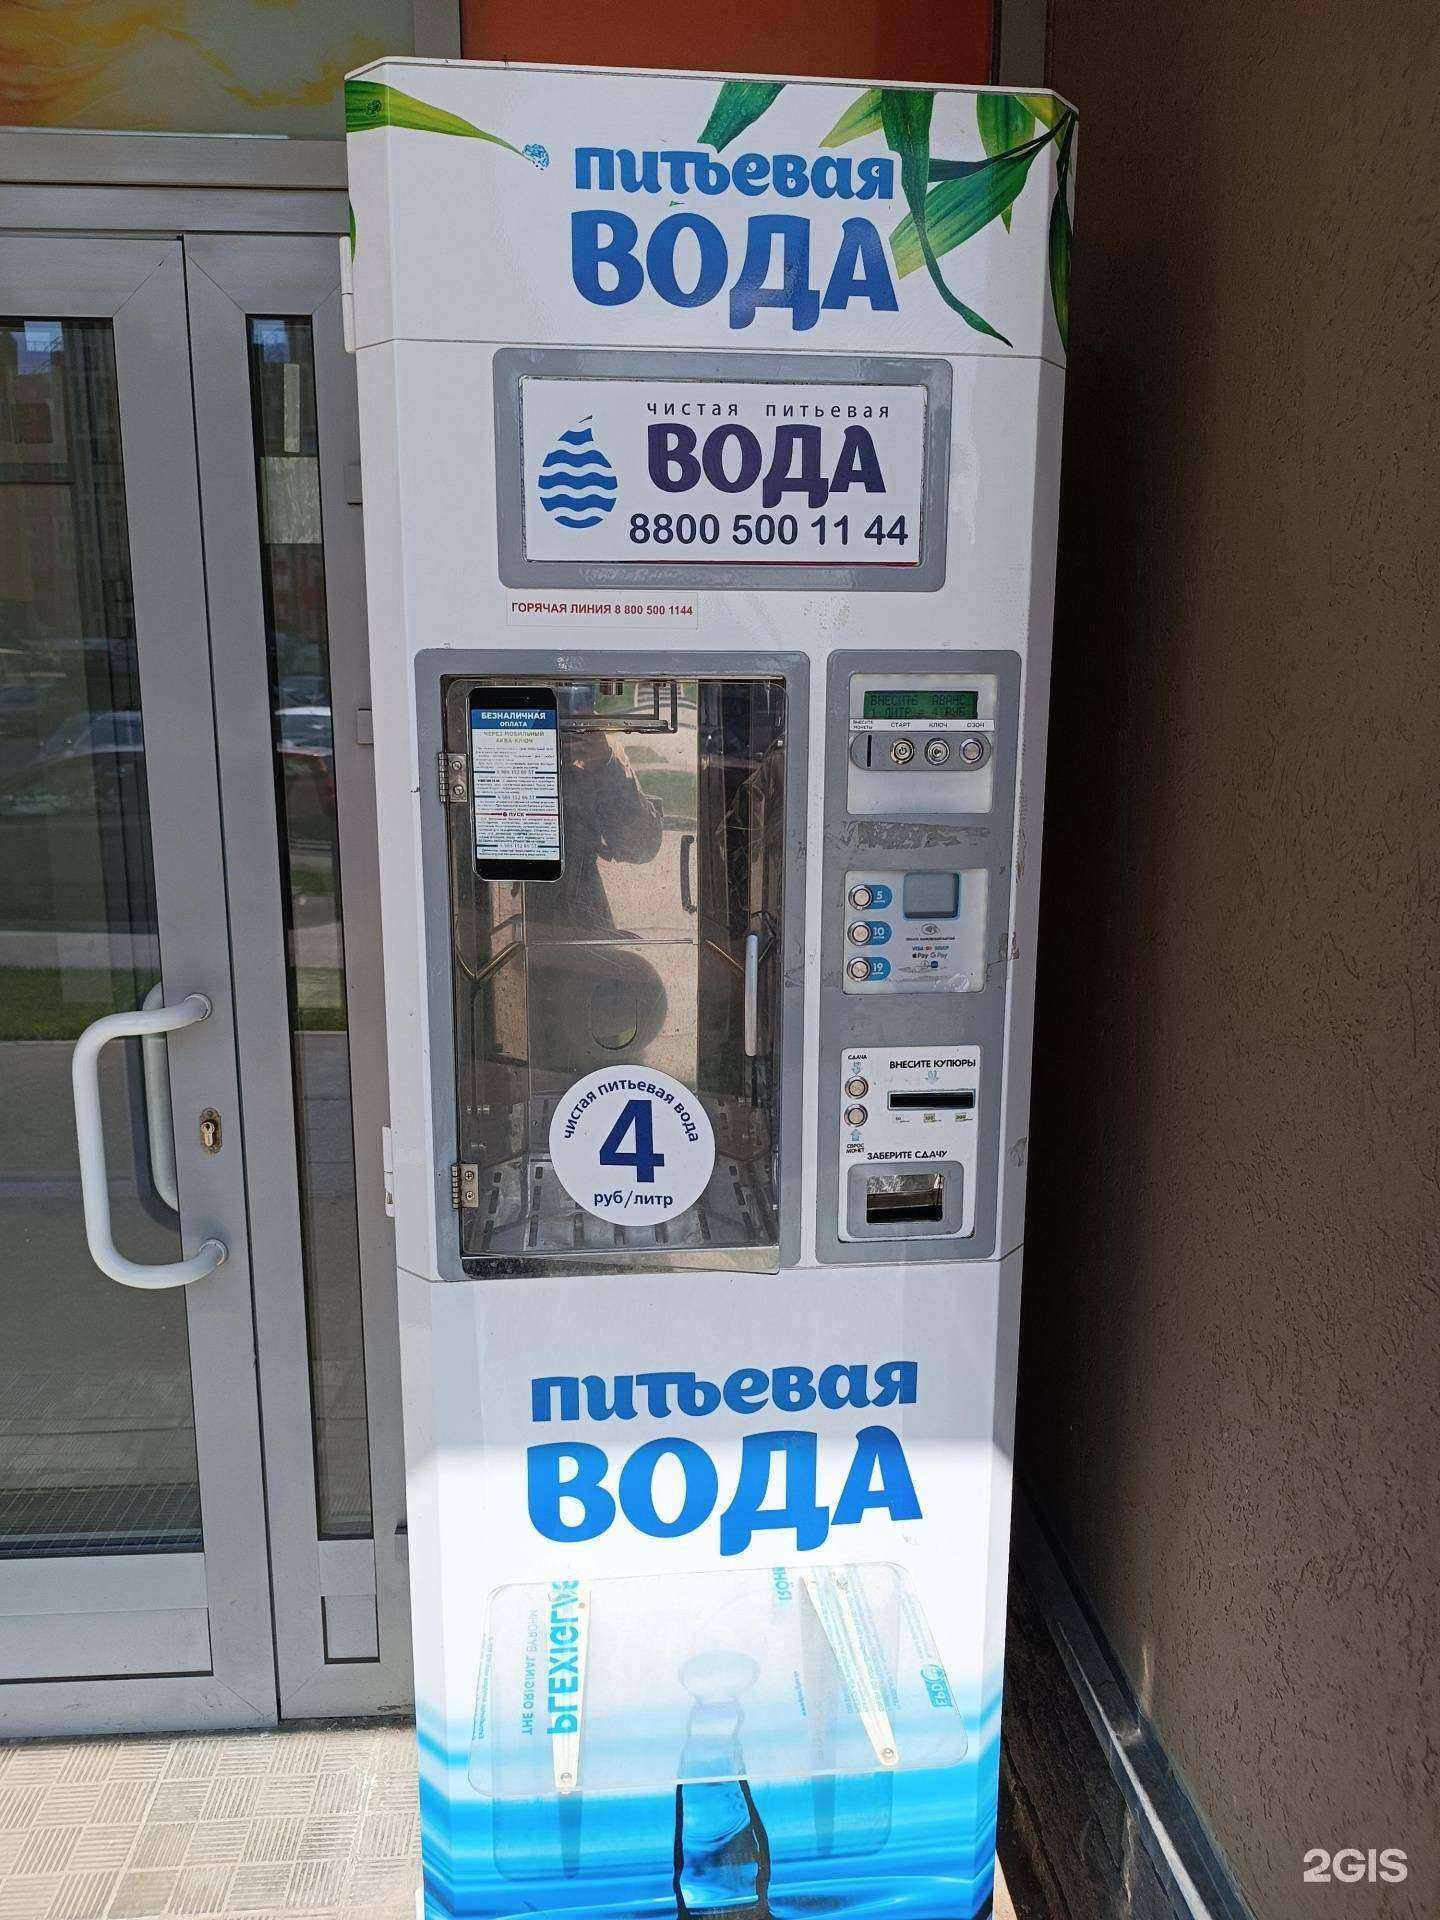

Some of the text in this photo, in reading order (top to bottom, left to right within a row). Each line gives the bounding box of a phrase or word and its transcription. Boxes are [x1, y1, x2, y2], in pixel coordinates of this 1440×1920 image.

[575, 146, 894, 200] питьевая
[570, 210, 900, 331] ВОДА
[646, 402, 891, 420] чистая питьевая
[647, 424, 886, 509] ВОДА
[629, 513, 909, 546] 8800 500 11 44
[511, 602, 693, 616] ГОРЯЧАЯ ЛИНИЯ 8 800 500 1144
[481, 712, 546, 720] БЕЗНАЛИЧНАЯ
[876, 891, 883, 899] 5
[873, 927, 885, 936] 10
[872, 963, 883, 971] 19
[889, 1059, 976, 1069] ВНЕСИТЕ КУПЮРЫ
[564, 1079, 699, 1142] чистая питьевая вода
[600, 1099, 665, 1183] 4
[866, 1150, 948, 1160] ЗАБЕРИТЕ СДАЧУ
[593, 1190, 674, 1208] руб/литр
[531, 1361, 918, 1422] питьевая
[527, 1425, 923, 1556] ВОДА
